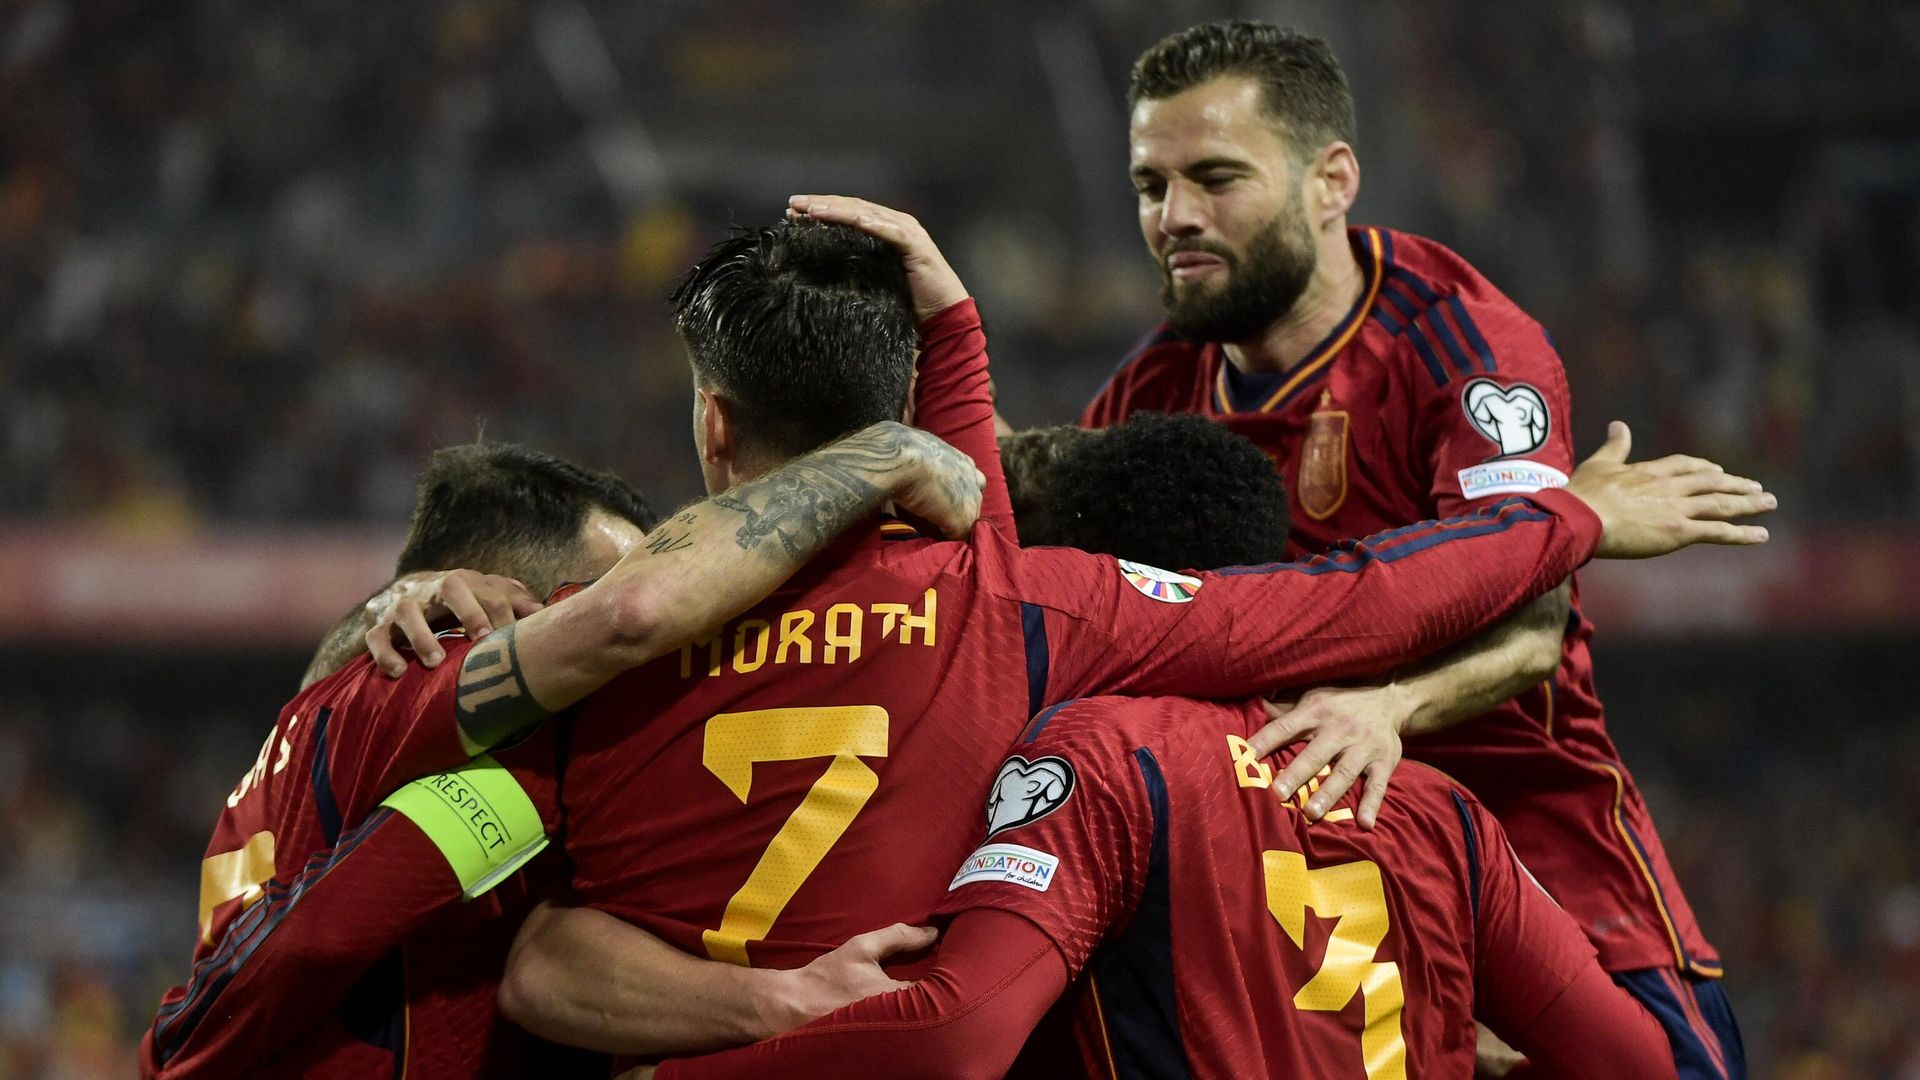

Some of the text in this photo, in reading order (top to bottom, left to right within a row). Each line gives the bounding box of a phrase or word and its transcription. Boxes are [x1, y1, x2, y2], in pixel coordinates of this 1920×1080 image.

[432, 773, 506, 850] RESPECT
[702, 705, 889, 967] 7
[1017, 876, 1044, 888] children
[1262, 850, 1406, 1080] 3
